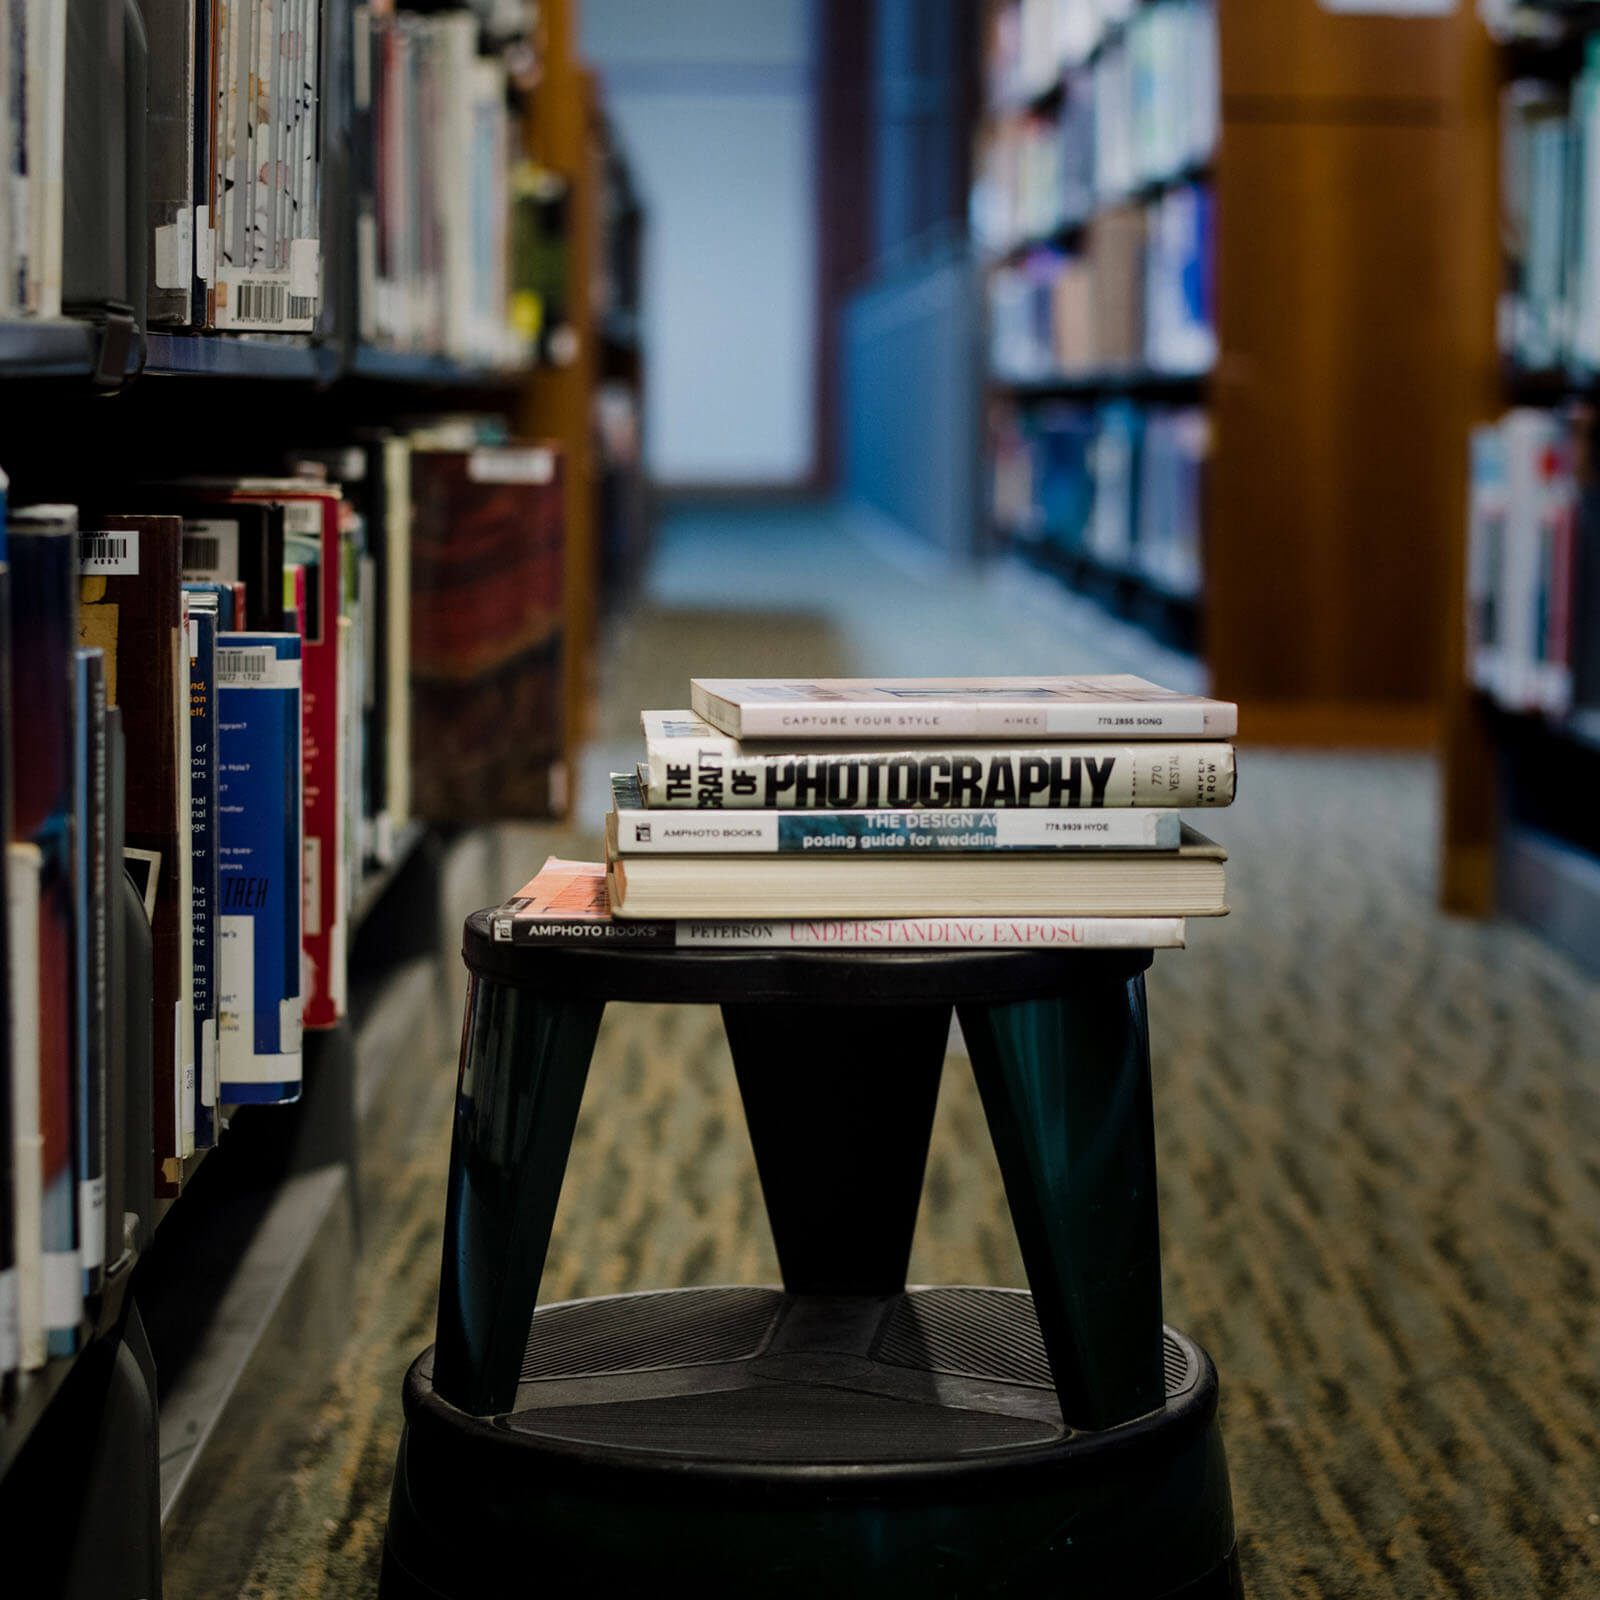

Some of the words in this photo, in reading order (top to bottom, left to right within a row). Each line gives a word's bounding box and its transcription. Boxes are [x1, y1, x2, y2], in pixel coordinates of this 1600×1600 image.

[782, 716, 847, 726] CAPTURE
[854, 716, 891, 726] YOUR
[898, 716, 940, 726] STYLE
[1003, 717, 1039, 725] AIMEE
[1136, 717, 1162, 726] SONG
[195, 743, 207, 753] of
[1151, 764, 1162, 785] 770
[1168, 754, 1180, 792] VESTAL
[1206, 763, 1217, 793] ROW
[666, 763, 692, 801] THE
[731, 768, 757, 796] OF
[764, 756, 1116, 808] PHOTOGRAPHY
[1197, 758, 1206, 806] ARPER
[865, 814, 900, 829] THE
[906, 814, 973, 829] DESIGN
[1084, 823, 1108, 831] HYDE
[663, 829, 720, 837] AMPHOTO
[722, 829, 762, 837] BOOKS
[803, 832, 857, 849] posing
[861, 832, 905, 849] guide
[909, 832, 933, 846] for
[528, 925, 602, 936] AMPHOTO
[605, 925, 657, 937] BOOKS
[690, 924, 773, 939] PETERSON
[789, 922, 984, 943] UNDERSTANDING
[992, 922, 1086, 942] EXPOSU
[192, 963, 206, 972] lm
[192, 1003, 206, 1011] ut
